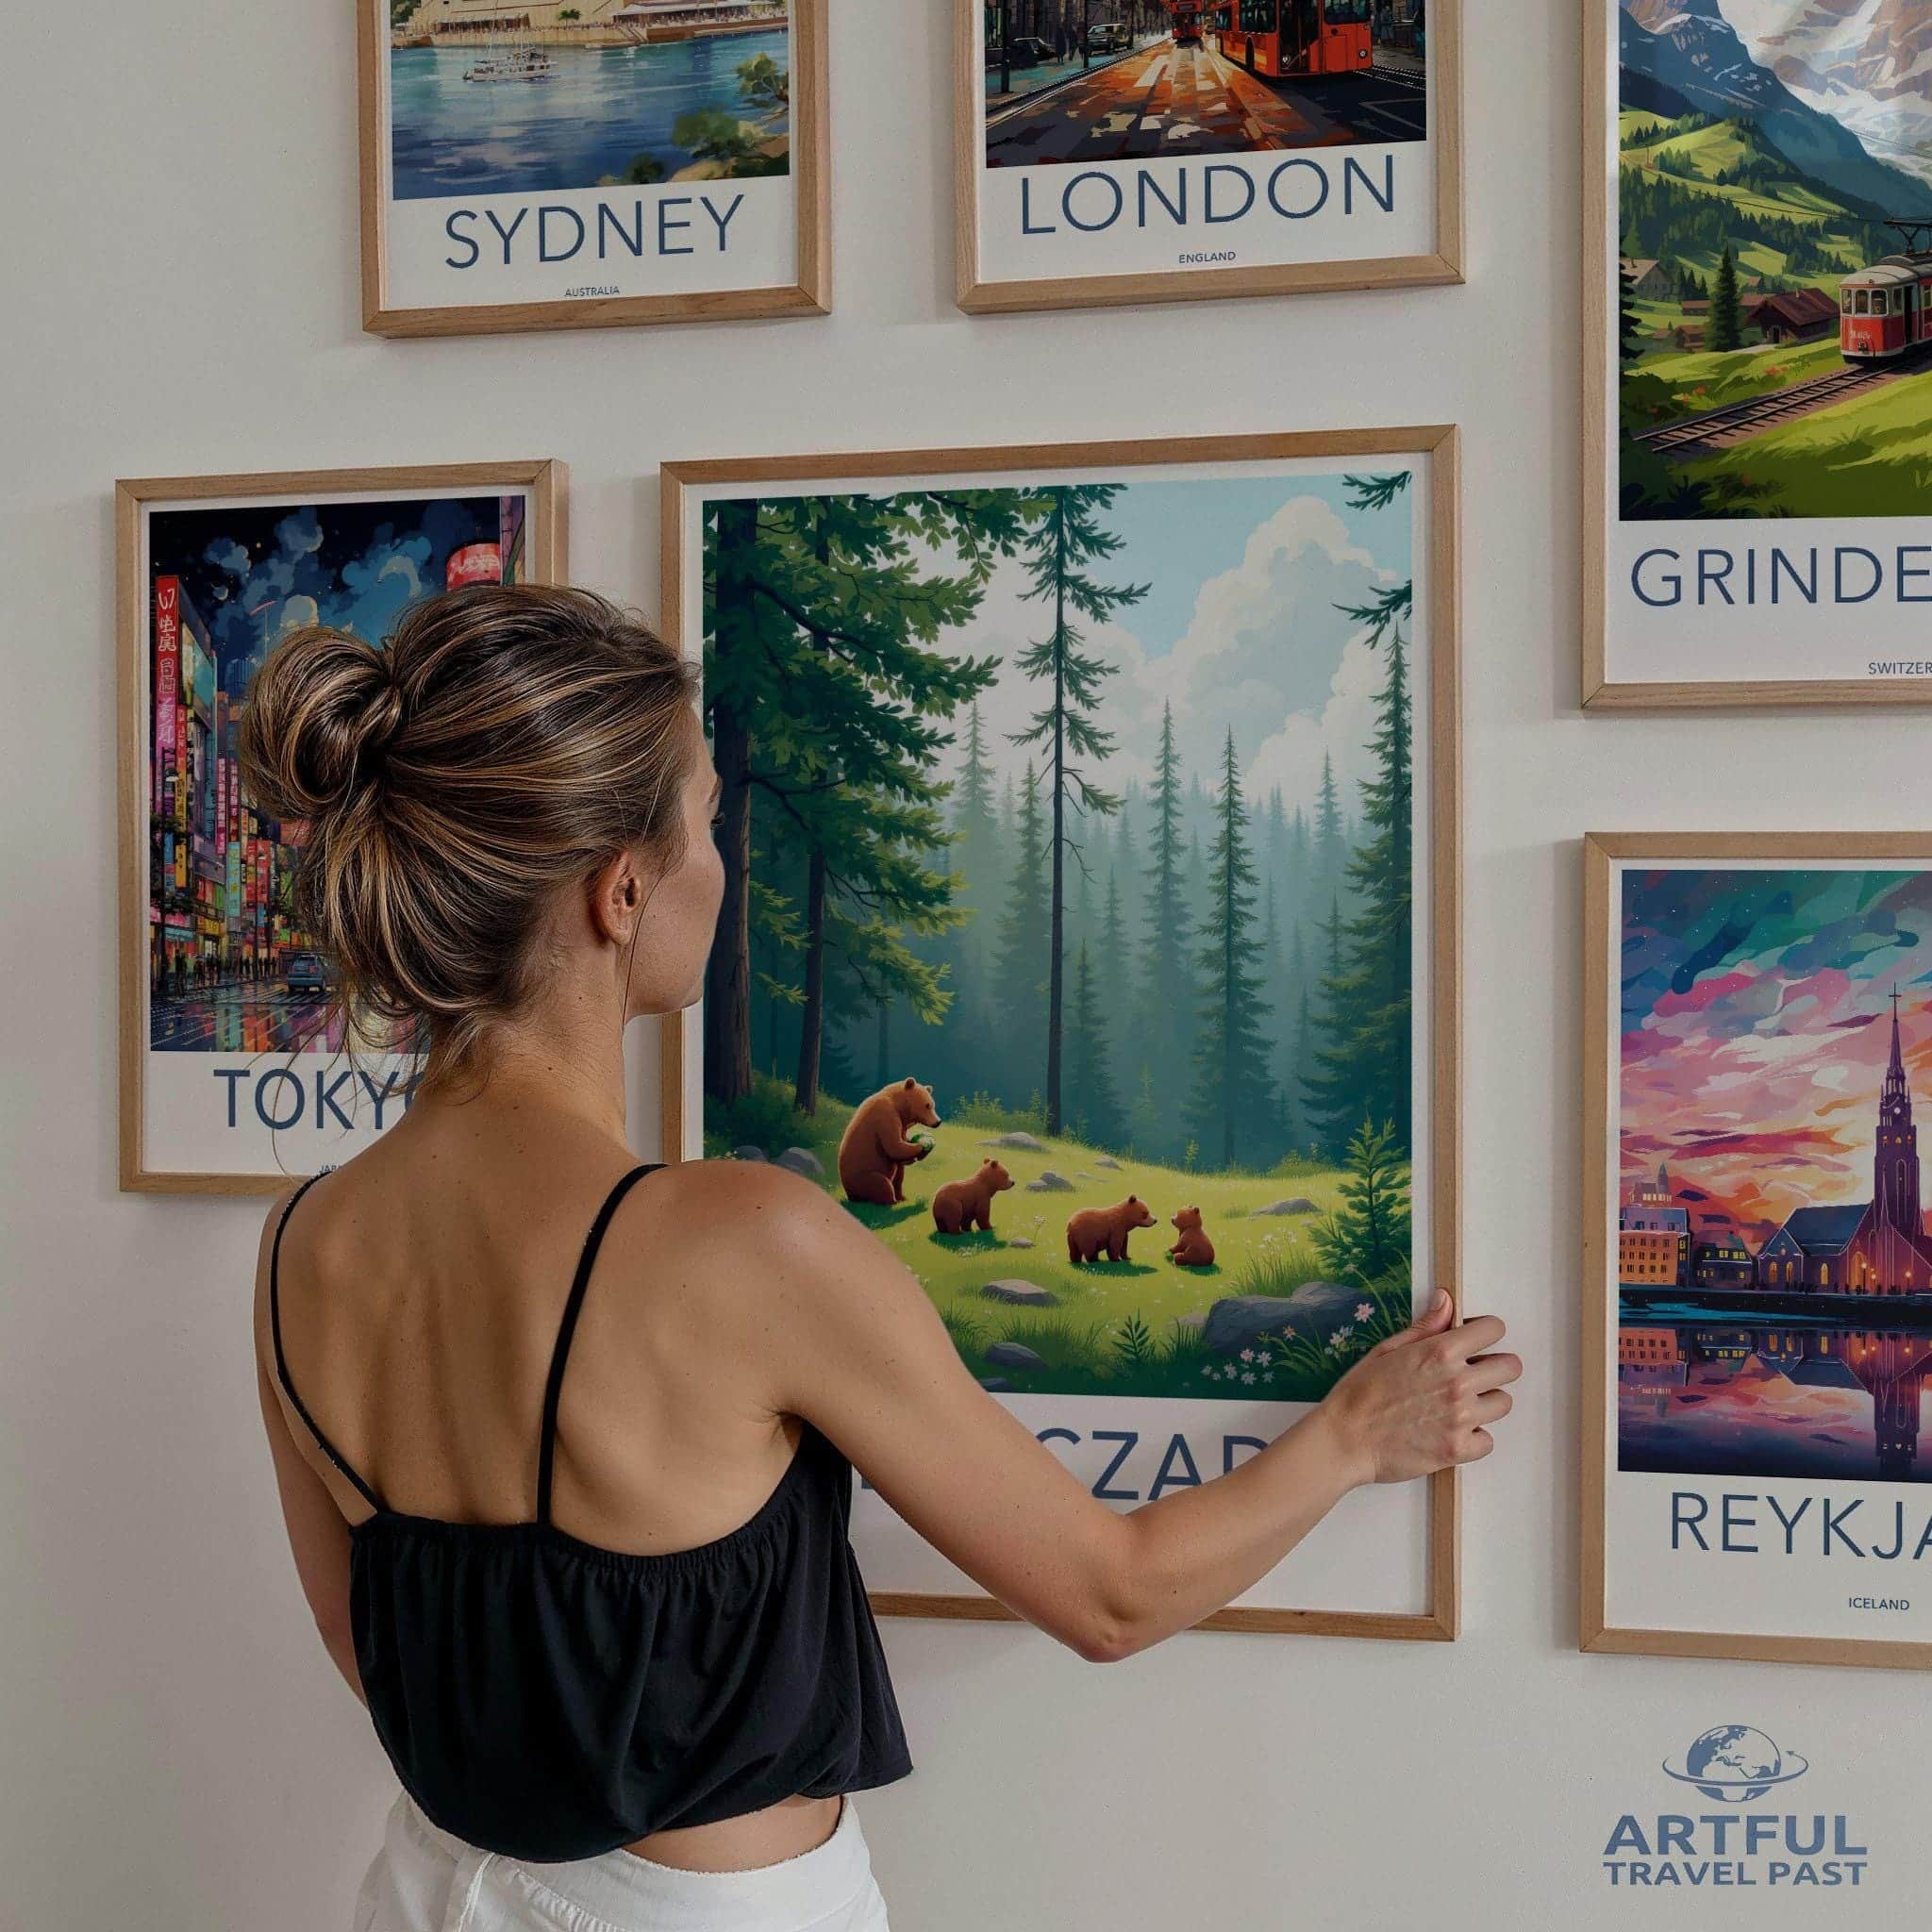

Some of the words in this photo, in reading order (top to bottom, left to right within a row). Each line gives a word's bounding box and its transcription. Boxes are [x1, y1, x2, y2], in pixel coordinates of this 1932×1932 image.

[1022, 155, 1393, 234] LONDON
[445, 193, 744, 269] SYDNEY
[1178, 251, 1236, 264] ENGLAND
[565, 285, 620, 297] AUSTRALIA
[1631, 545, 1932, 607] GRINDE
[1848, 1597, 1910, 1611] ICELAND
